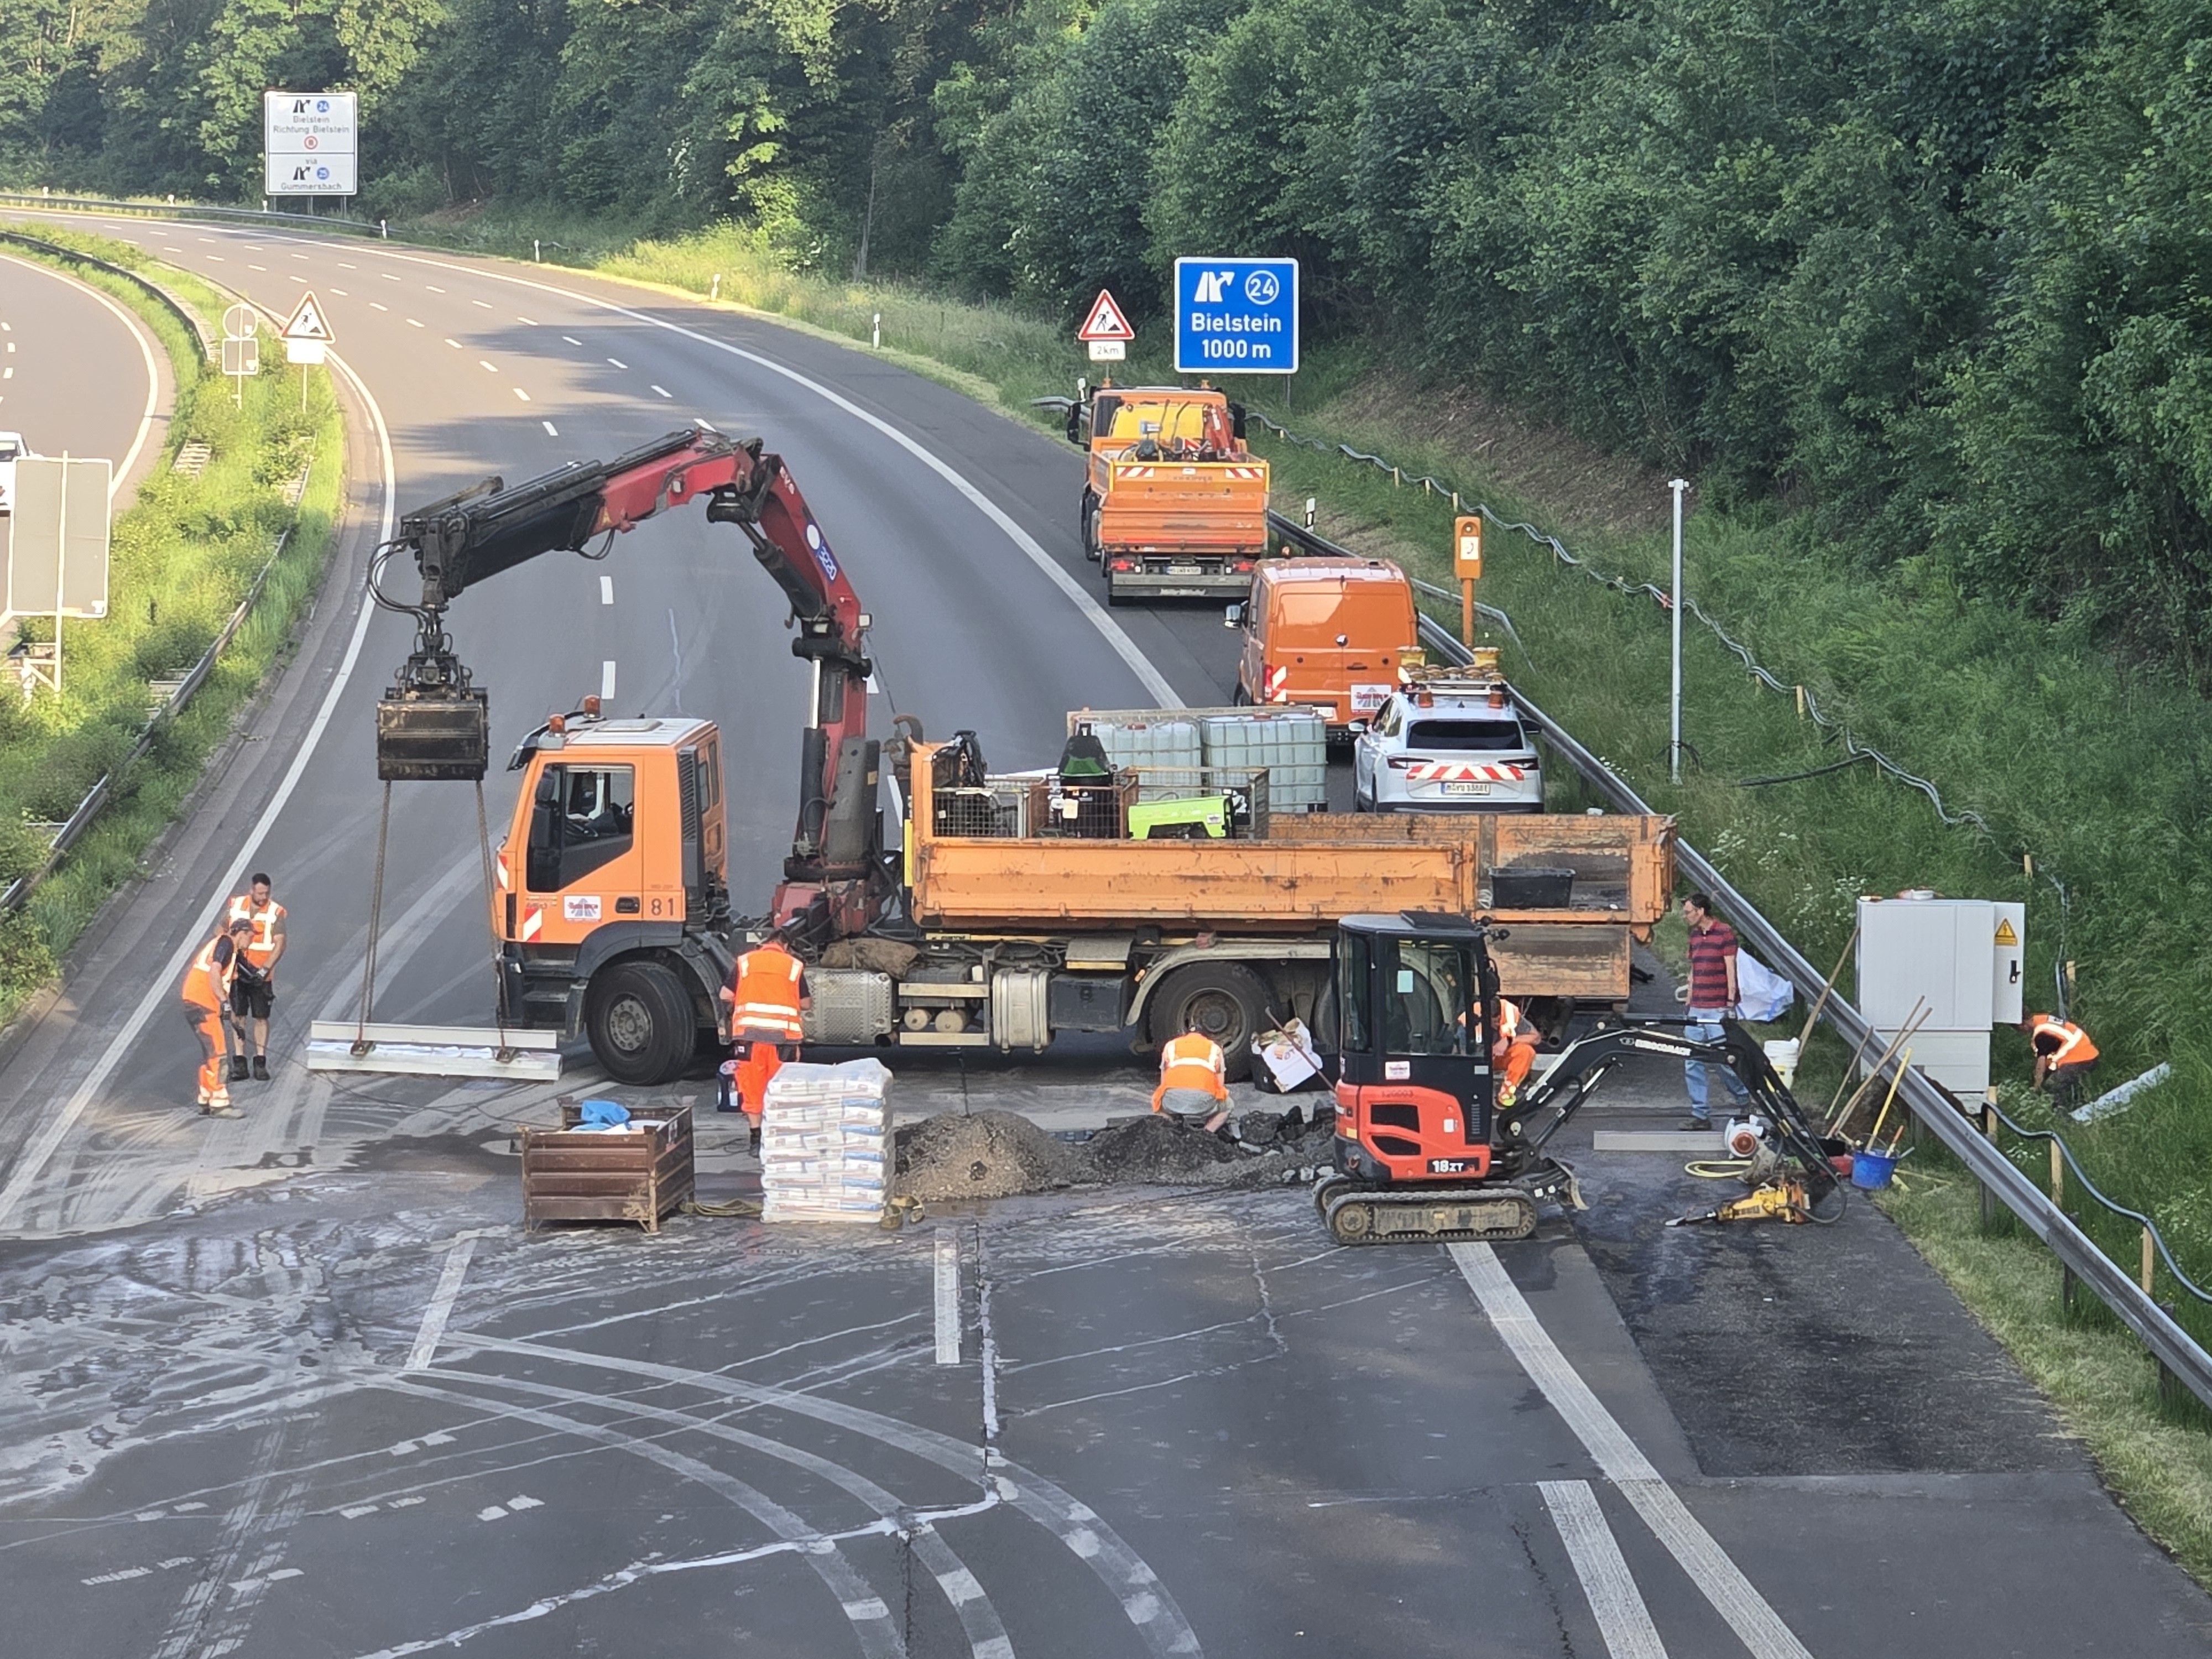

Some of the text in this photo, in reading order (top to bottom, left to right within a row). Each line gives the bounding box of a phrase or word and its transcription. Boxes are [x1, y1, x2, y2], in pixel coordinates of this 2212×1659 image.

[273, 125, 350, 134] Richtung Bielstein
[1250, 278, 1275, 298] 24
[1191, 312, 1281, 332] Bielstein
[1202, 340, 1271, 358] 1000 m
[651, 898, 674, 916] 81
[1432, 1159, 1464, 1173] 18ZT
